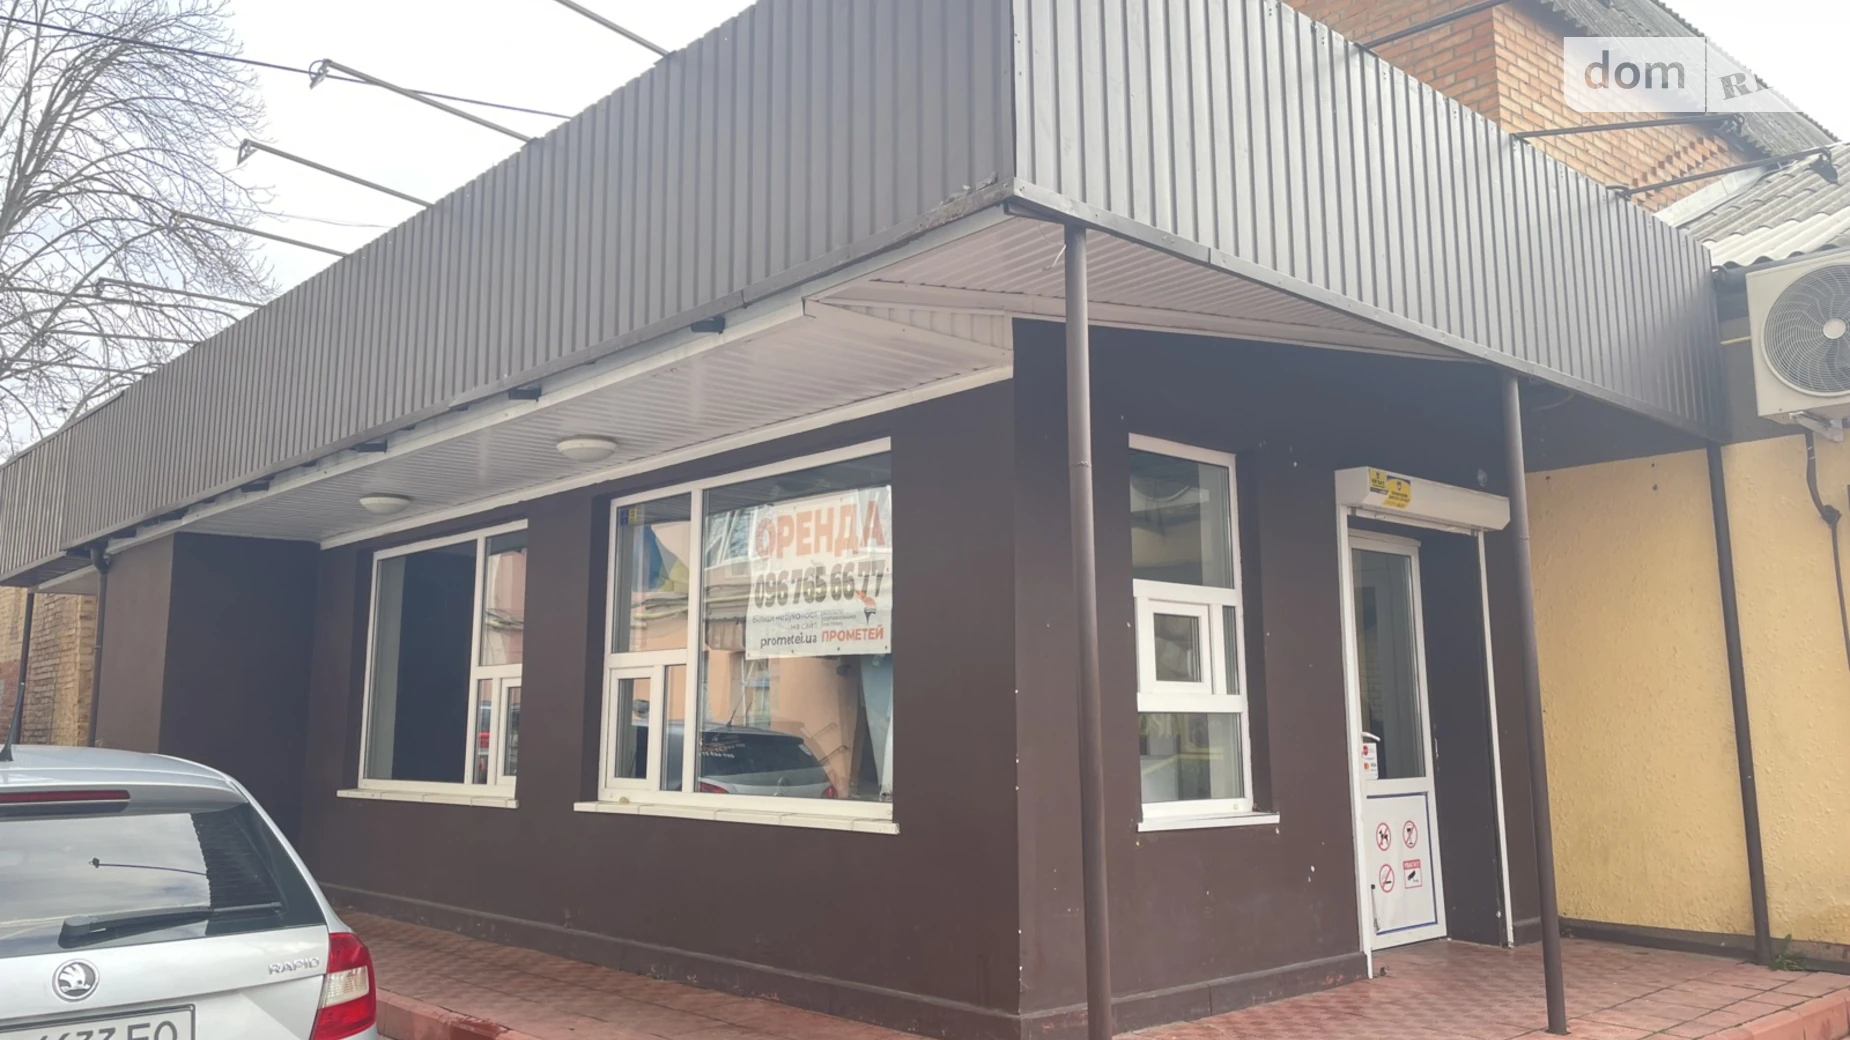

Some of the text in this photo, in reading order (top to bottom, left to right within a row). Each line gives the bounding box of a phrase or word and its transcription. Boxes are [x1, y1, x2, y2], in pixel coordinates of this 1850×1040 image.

[755, 500, 886, 561] ОРЕНДА
[754, 559, 886, 609] 096 765 66 77
[760, 632, 818, 649] prometei.ua
[821, 624, 885, 643] ПРОМЕТЕЙ
[267, 957, 320, 975] RAPID
